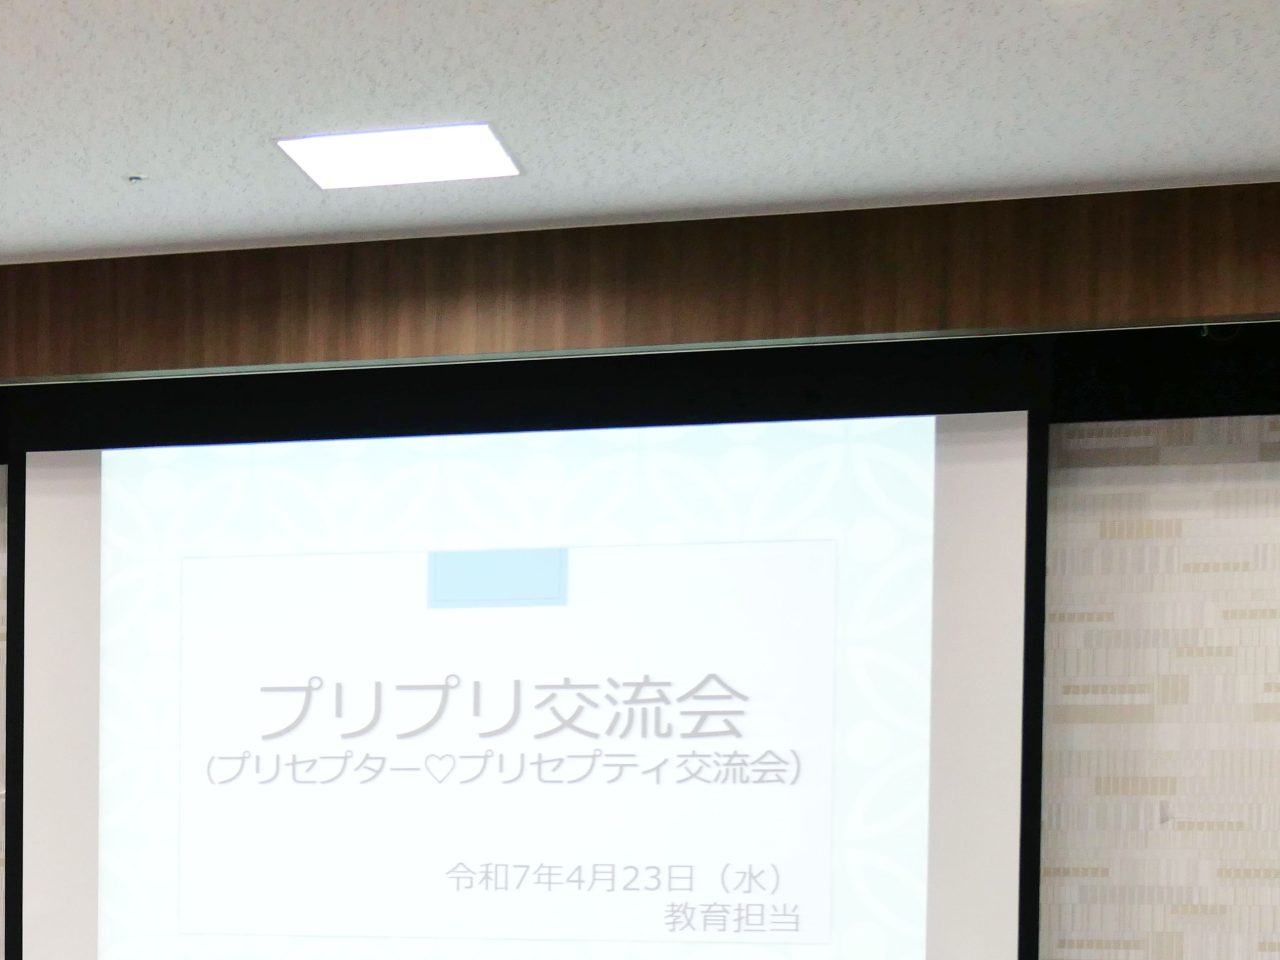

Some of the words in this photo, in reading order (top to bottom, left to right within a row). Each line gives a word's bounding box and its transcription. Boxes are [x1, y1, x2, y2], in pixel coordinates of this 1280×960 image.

[260, 673, 750, 740] プリプリ交流会
[665, 902, 800, 933] 教育担当
